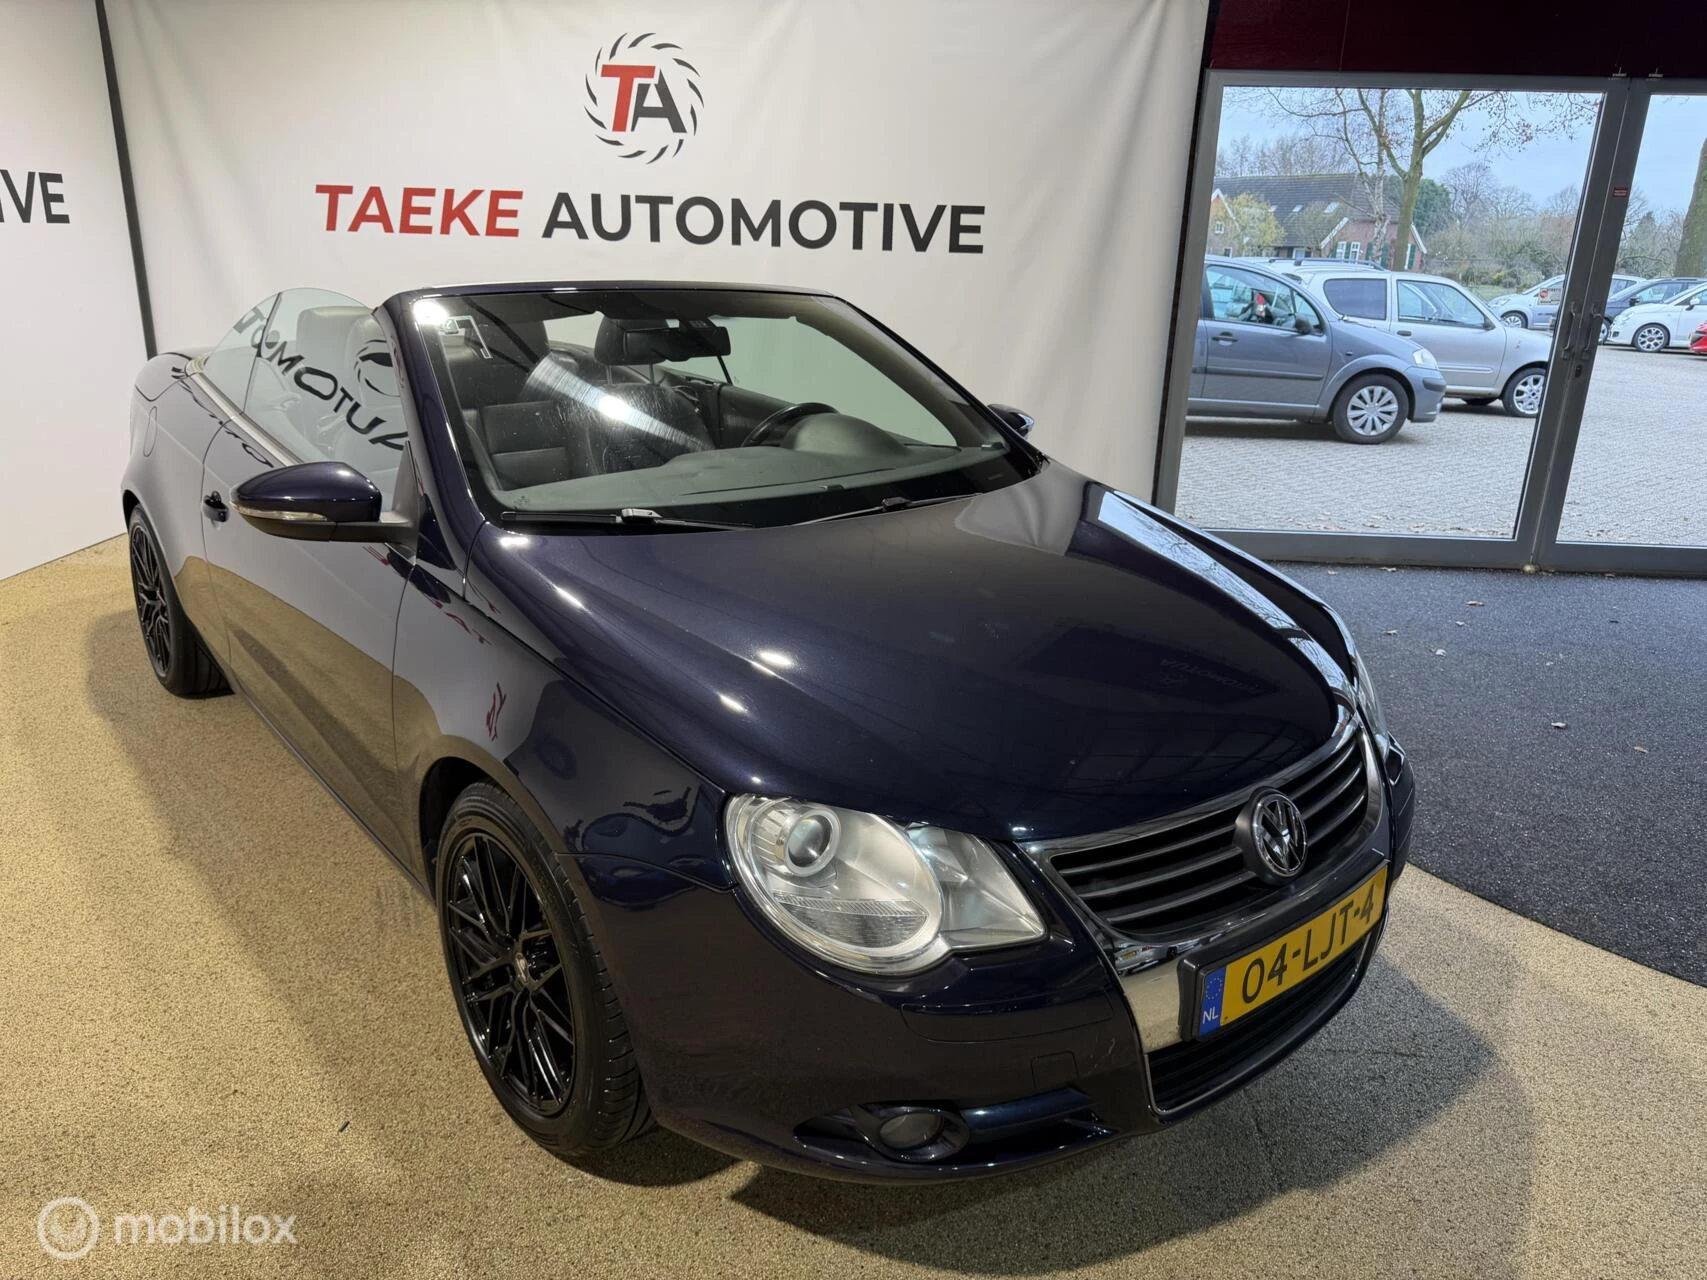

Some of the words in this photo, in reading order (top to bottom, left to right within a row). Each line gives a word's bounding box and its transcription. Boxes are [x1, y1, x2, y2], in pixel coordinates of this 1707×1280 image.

[601, 64, 687, 134] TA
[315, 184, 524, 237] TAEKE
[542, 192, 986, 254] AUTOMOTIVE
[1242, 883, 1375, 1004] 04-LJT-4
[1202, 1007, 1219, 1024] NL
